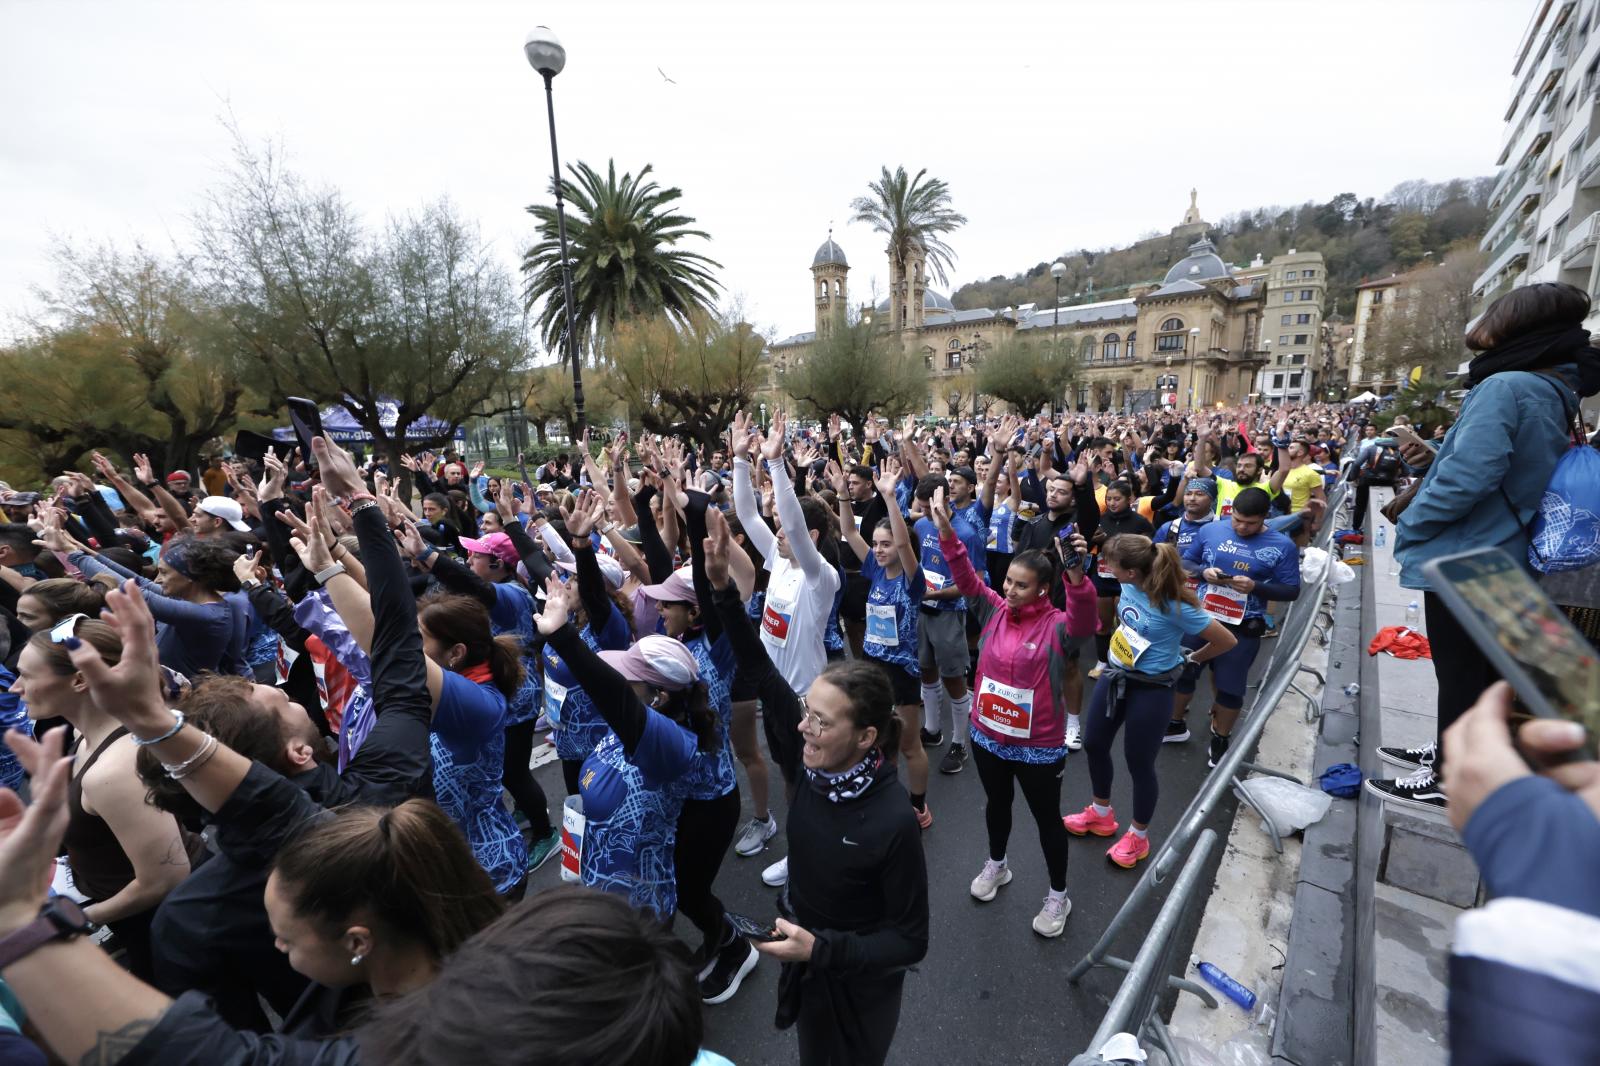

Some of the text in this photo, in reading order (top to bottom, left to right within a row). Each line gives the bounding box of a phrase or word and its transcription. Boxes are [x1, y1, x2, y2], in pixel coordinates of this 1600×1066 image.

[997, 688, 1023, 700] ZURICH
[992, 703, 1020, 718] PILAR
[992, 713, 1012, 725] 10919
